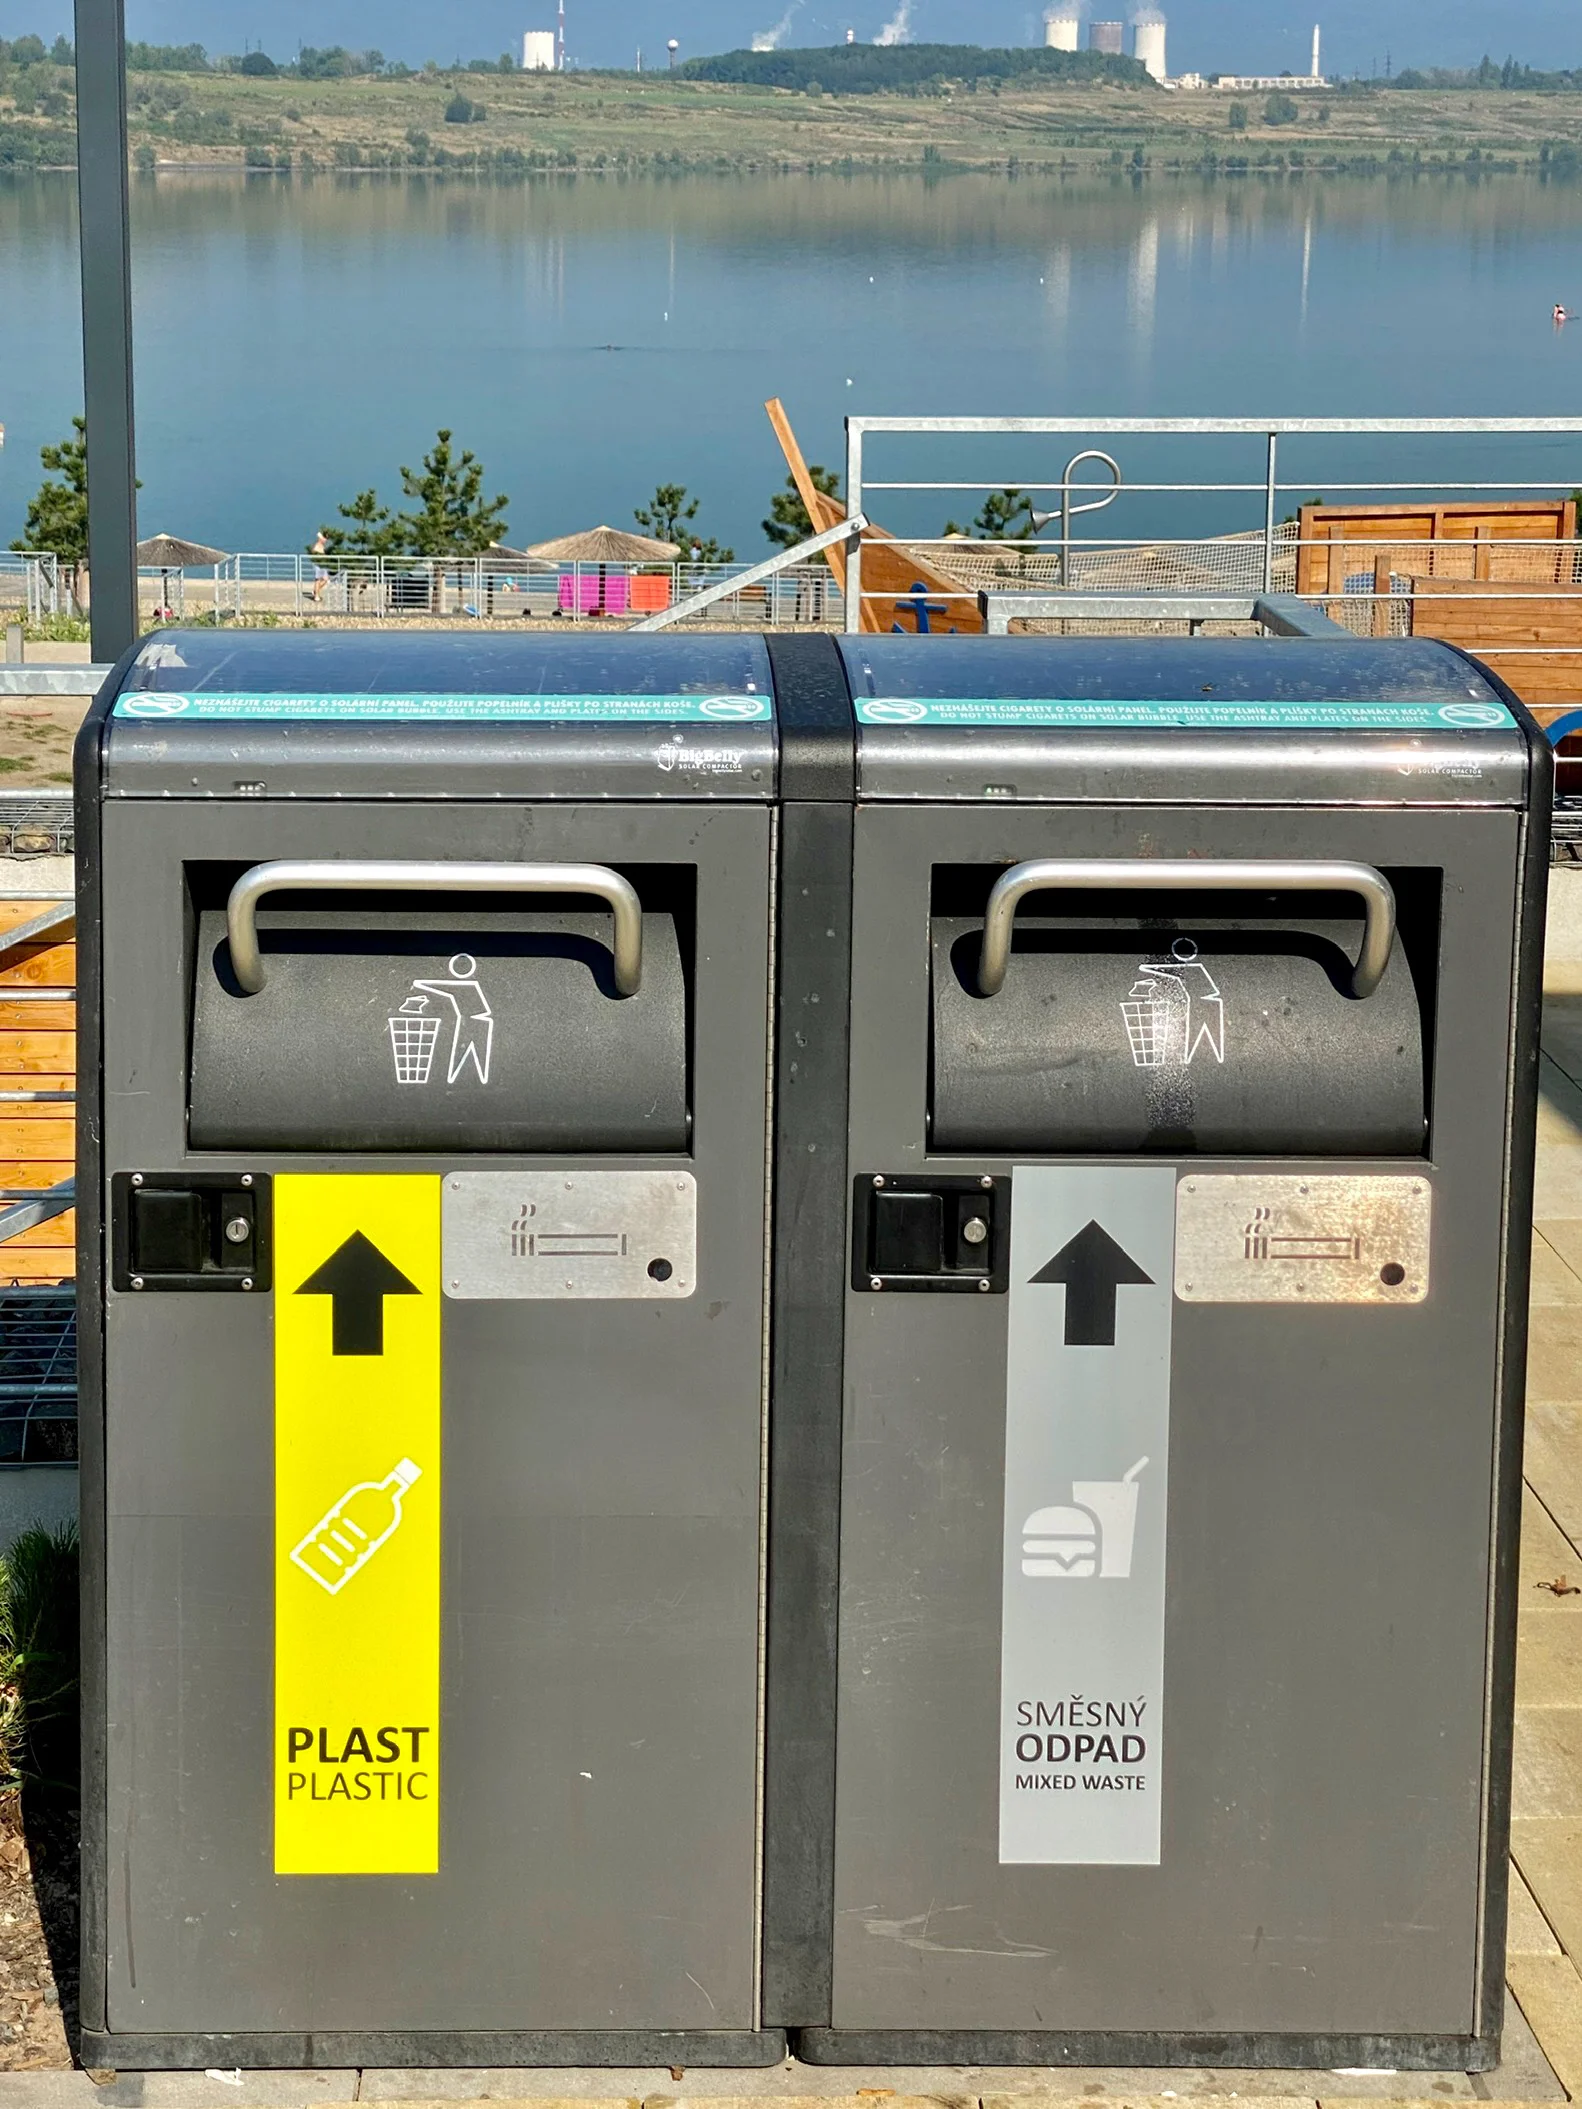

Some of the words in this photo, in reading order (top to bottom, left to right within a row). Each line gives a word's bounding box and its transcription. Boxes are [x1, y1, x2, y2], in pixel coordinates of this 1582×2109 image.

[262, 699, 317, 707] CIGARETY
[319, 699, 329, 707] O
[331, 699, 380, 707] SOLÁRNÍ
[476, 699, 531, 707] POPELNÍK
[603, 700, 661, 708] STRANÁCH
[663, 700, 696, 708] KOŠE.
[1067, 705, 1115, 713] SOLÁRNÍ
[1118, 706, 1156, 714] PANEL.
[1212, 706, 1267, 714] POPELNÍK
[1280, 706, 1317, 715] PLÍŠKY
[1339, 707, 1398, 715] STRANÁCH
[1399, 708, 1434, 716] KOŠE.
[678, 749, 743, 764] BigBelly
[1016, 1694, 1147, 1727] SMĚSNÝ
[288, 1727, 430, 1763] PLAST
[1015, 1733, 1146, 1763] ODPAD
[288, 1772, 428, 1801] PLASTIC
[1015, 1774, 1077, 1790] MIXED
[1082, 1775, 1146, 1791] WASTE
